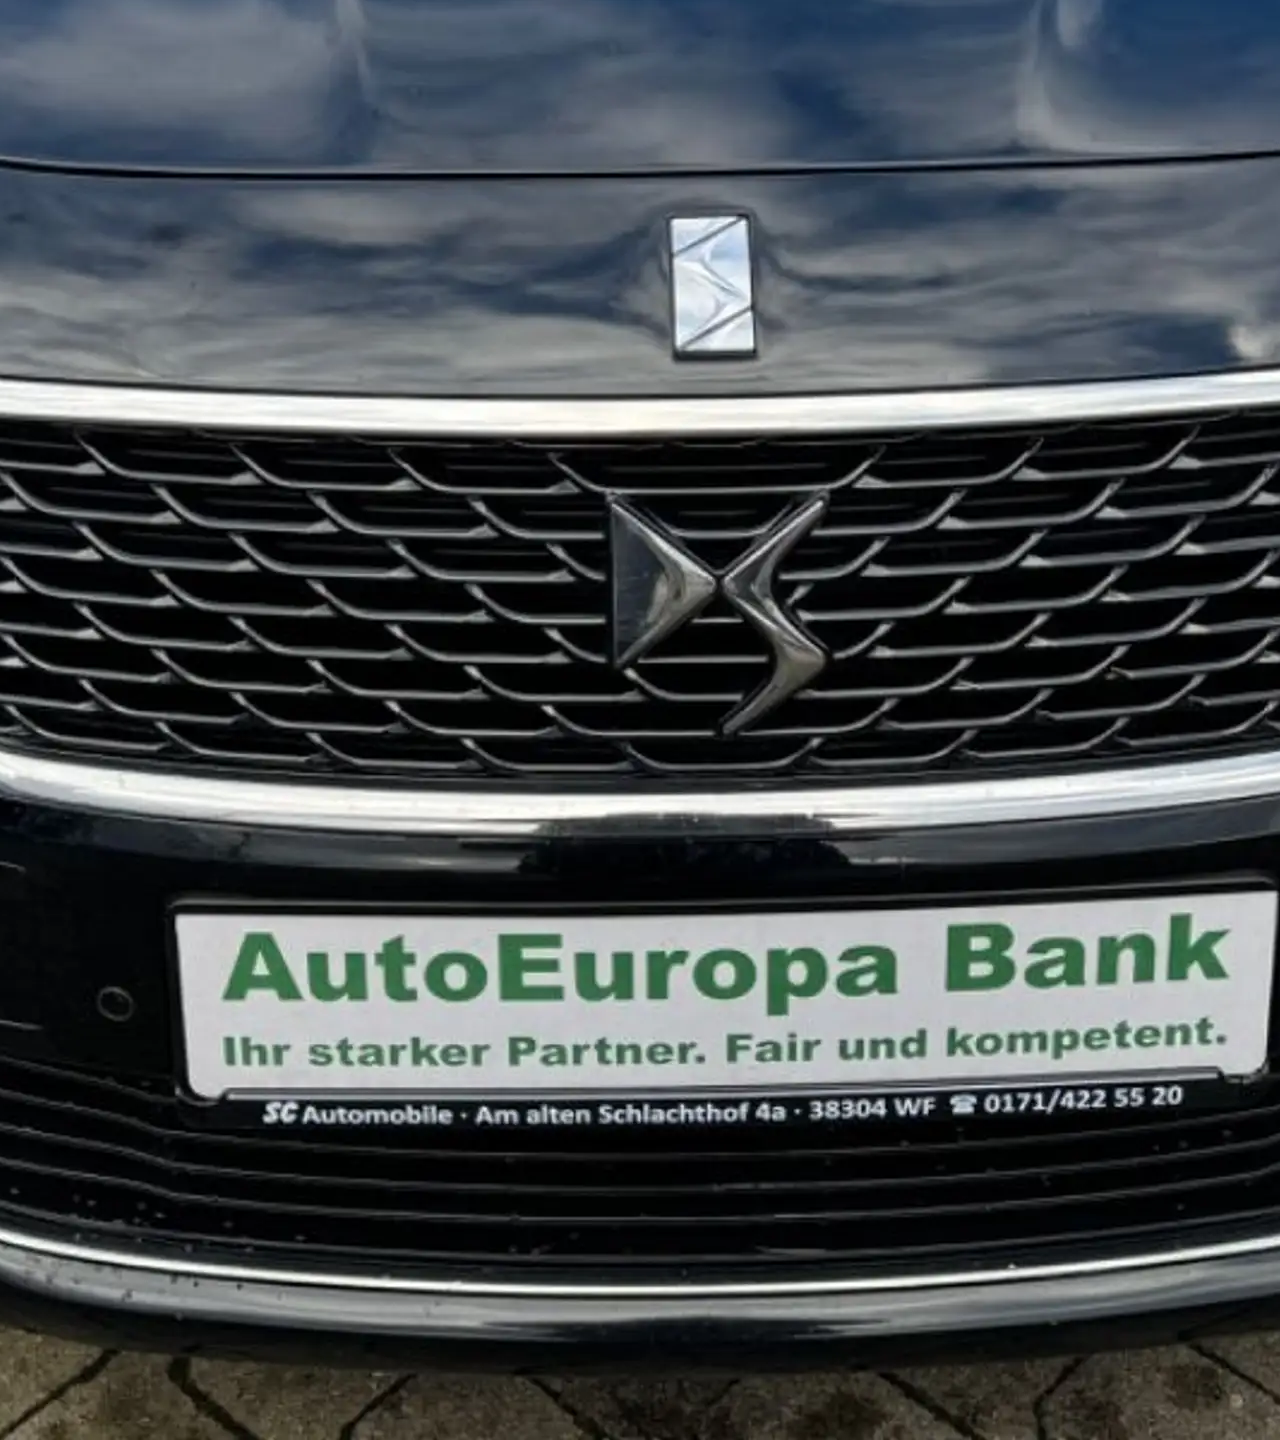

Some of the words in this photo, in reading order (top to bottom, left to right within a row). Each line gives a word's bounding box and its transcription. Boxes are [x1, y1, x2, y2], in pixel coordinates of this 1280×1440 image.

[222, 931, 898, 1016] AutoEuropa
[944, 913, 1231, 992] Bank
[222, 1036, 291, 1067] Ihr
[308, 1036, 491, 1067] starker
[508, 1035, 706, 1067] Partner.
[726, 1032, 822, 1064] Fair
[839, 1028, 928, 1061] und
[947, 1016, 1227, 1060] kompetent.
[263, 1101, 300, 1124] SC
[302, 1105, 454, 1125] Automobile
[475, 1106, 519, 1125] Am
[526, 1105, 592, 1125] alten
[598, 1100, 749, 1124] Schlachthof
[755, 1101, 787, 1122] 4a
[808, 1099, 887, 1119] 38304
[895, 1098, 936, 1117] WF
[983, 1088, 1107, 1114] 0171/422
[1113, 1087, 1144, 1108] 55
[1152, 1084, 1183, 1106] 20
